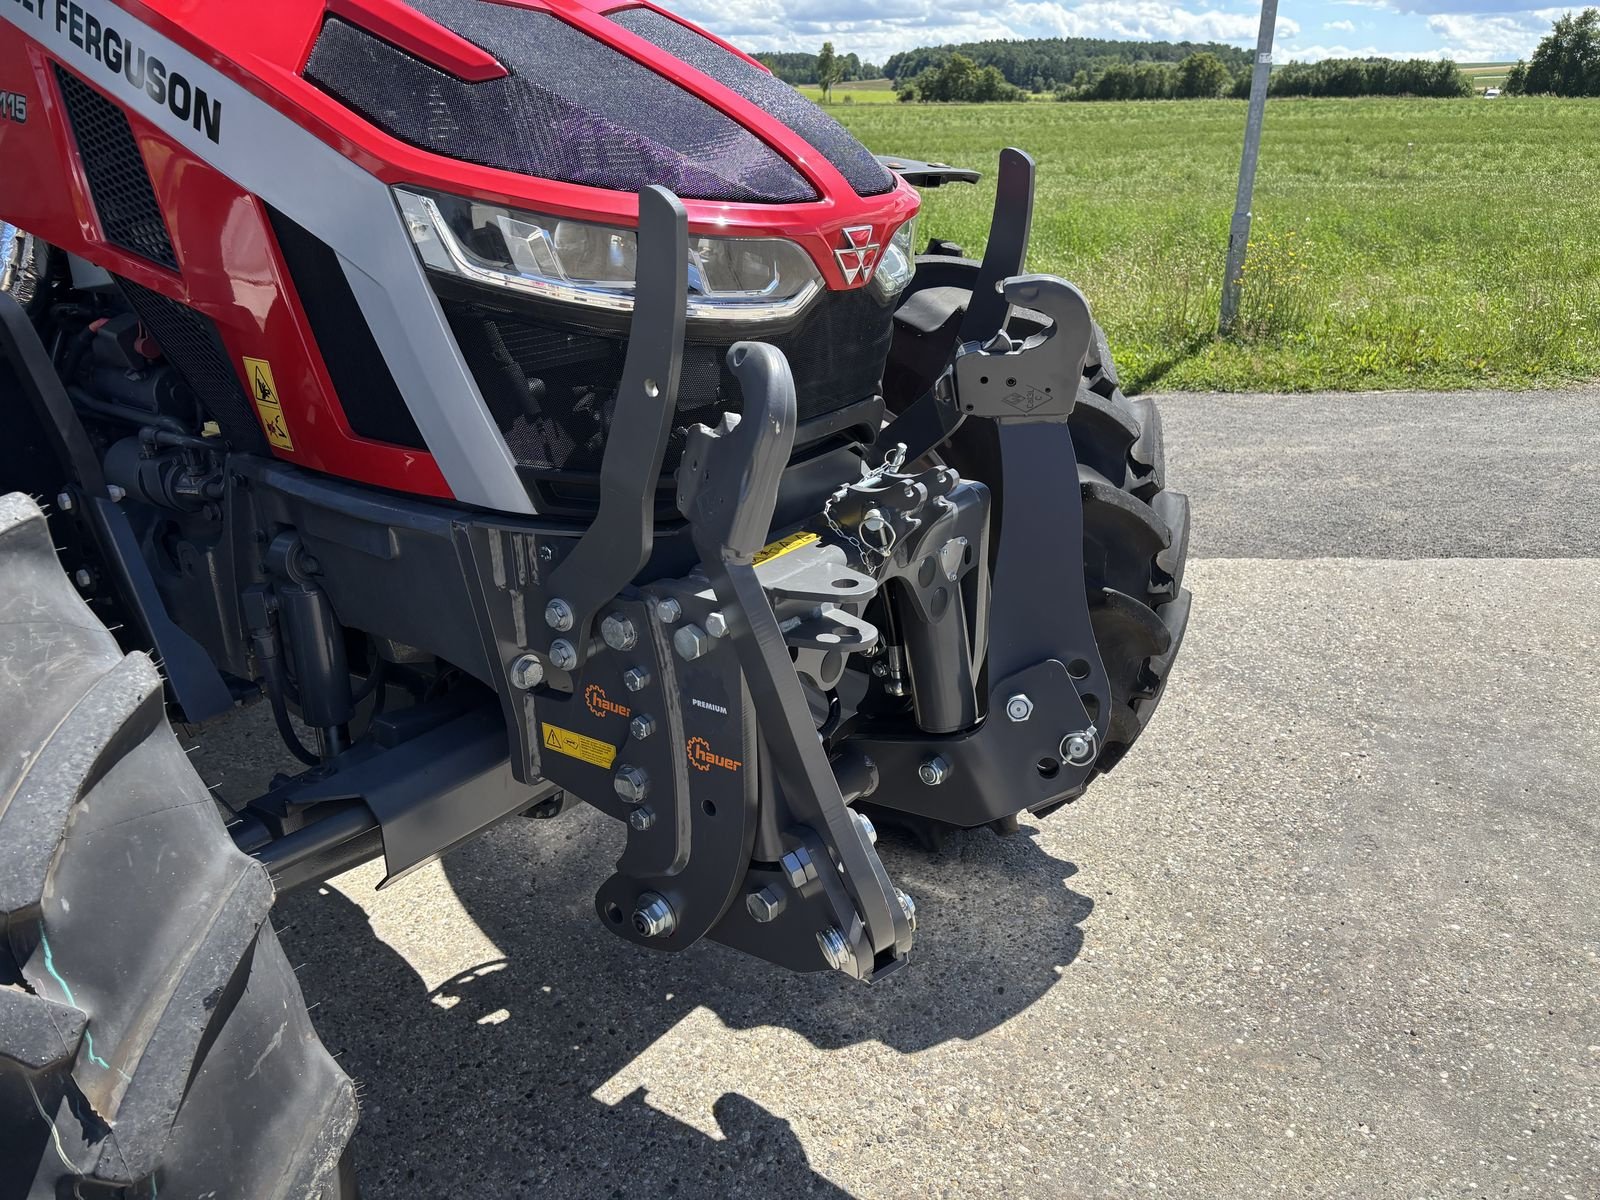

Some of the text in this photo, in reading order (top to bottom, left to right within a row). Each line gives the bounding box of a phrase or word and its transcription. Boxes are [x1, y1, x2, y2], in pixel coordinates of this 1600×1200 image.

[56, 0, 221, 144] FERGUSON
[692, 698, 727, 714] PREMIUM
[696, 744, 741, 771] hauer
